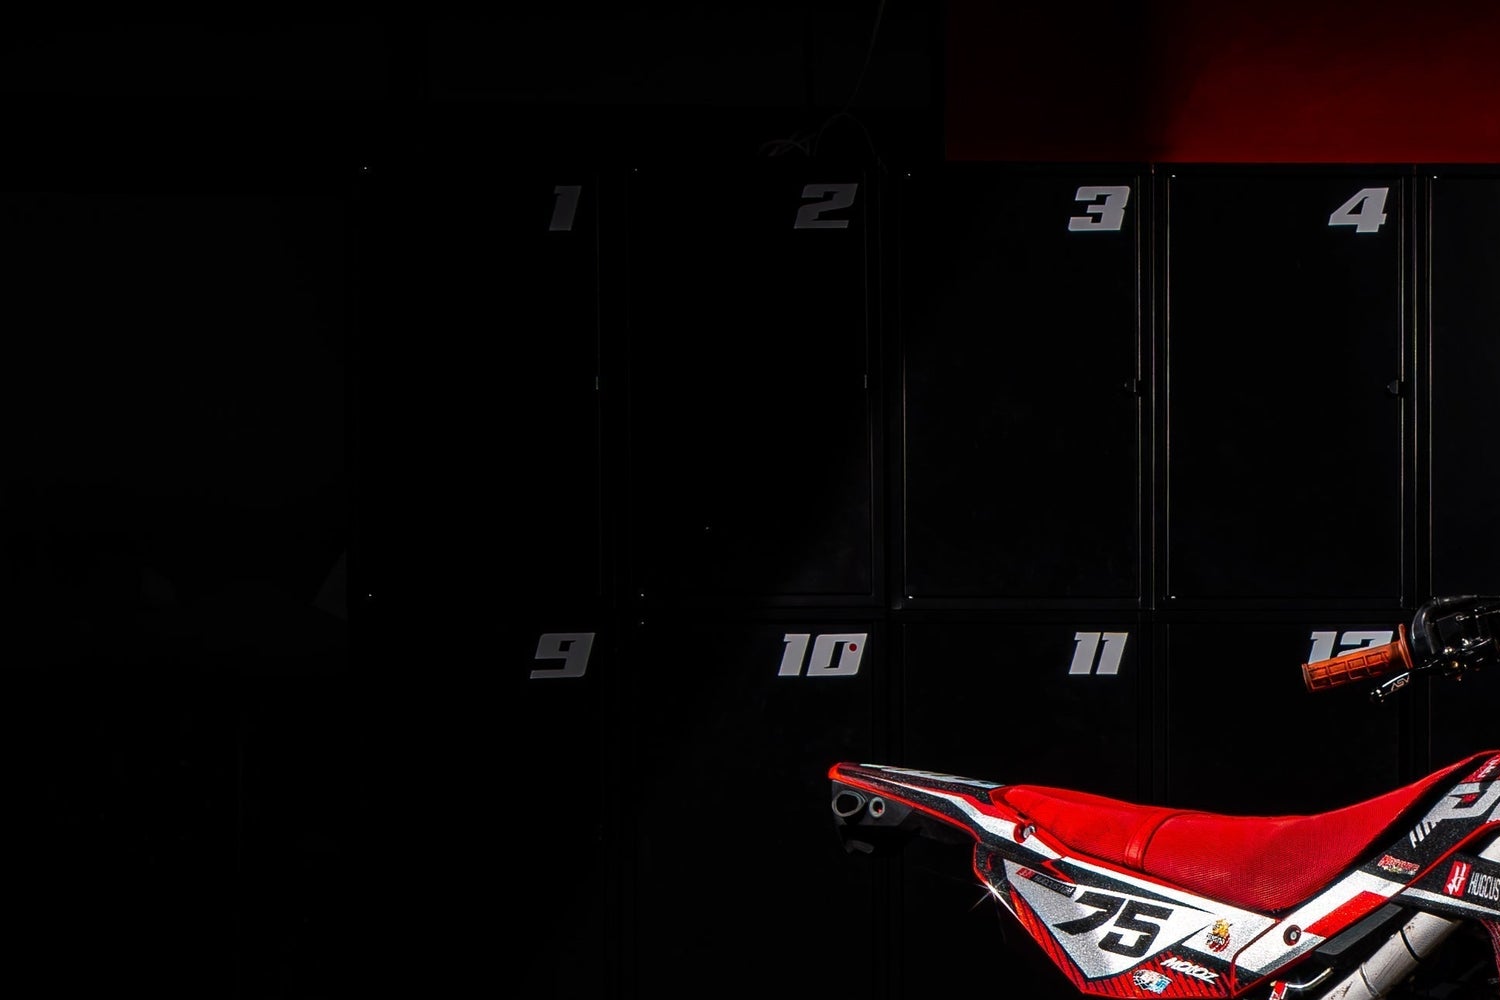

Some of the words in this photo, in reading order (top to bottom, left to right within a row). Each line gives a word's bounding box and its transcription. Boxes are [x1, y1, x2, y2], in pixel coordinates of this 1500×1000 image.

[549, 186, 582, 231] 1
[794, 184, 858, 229] 2
[1068, 186, 1130, 231] 3
[1329, 188, 1389, 233] 4
[530, 633, 596, 679] 9
[778, 633, 868, 677] 10
[1069, 632, 1129, 675] 11
[1053, 890, 1174, 958] 75
